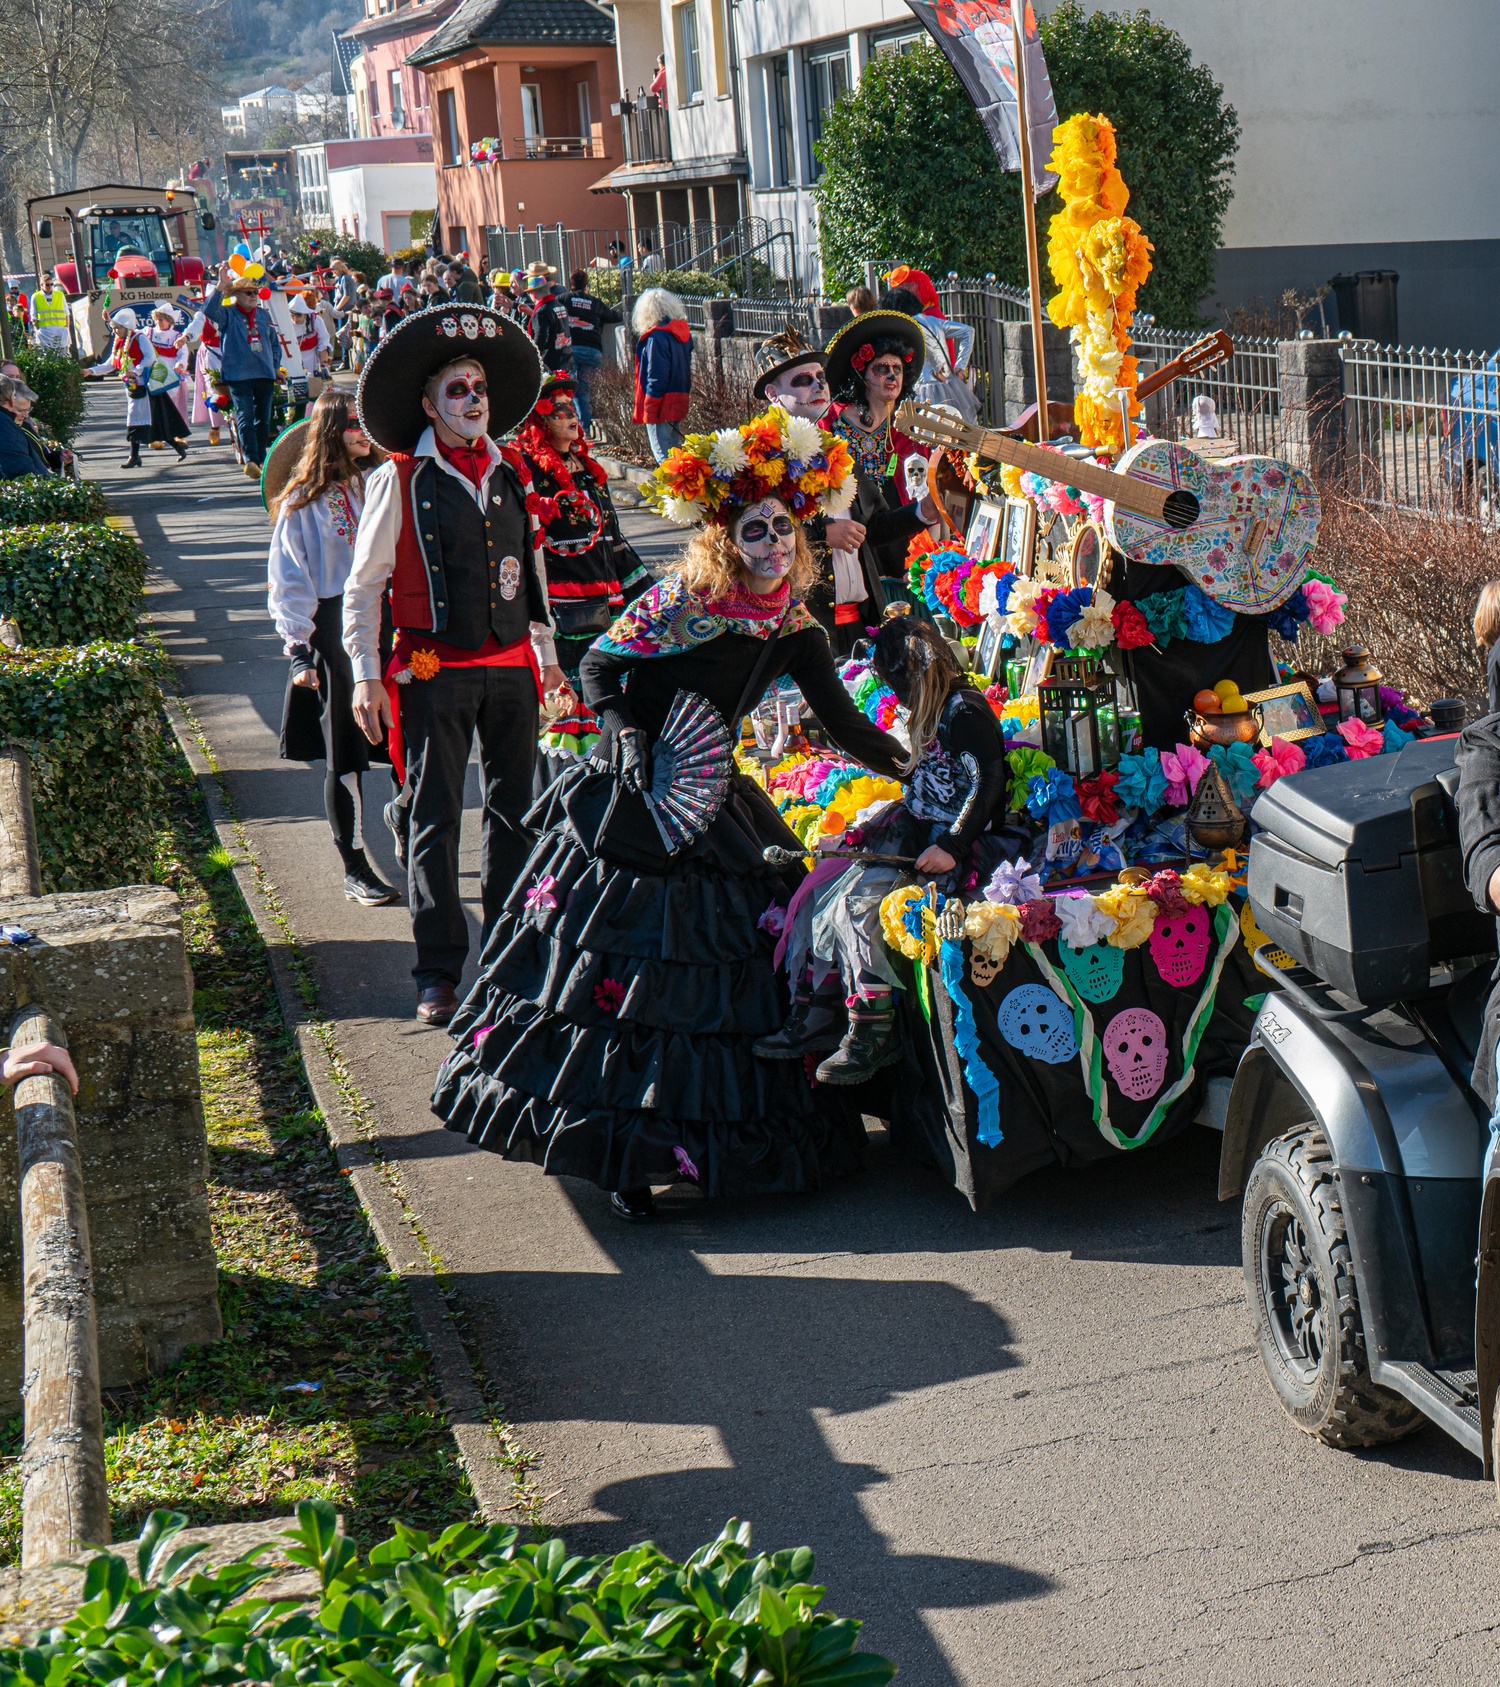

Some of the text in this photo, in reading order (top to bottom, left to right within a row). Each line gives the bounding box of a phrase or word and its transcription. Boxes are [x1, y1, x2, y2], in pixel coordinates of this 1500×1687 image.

[120, 290, 173, 301] KG Holzem
[1259, 1011, 1292, 1044] 4x4
